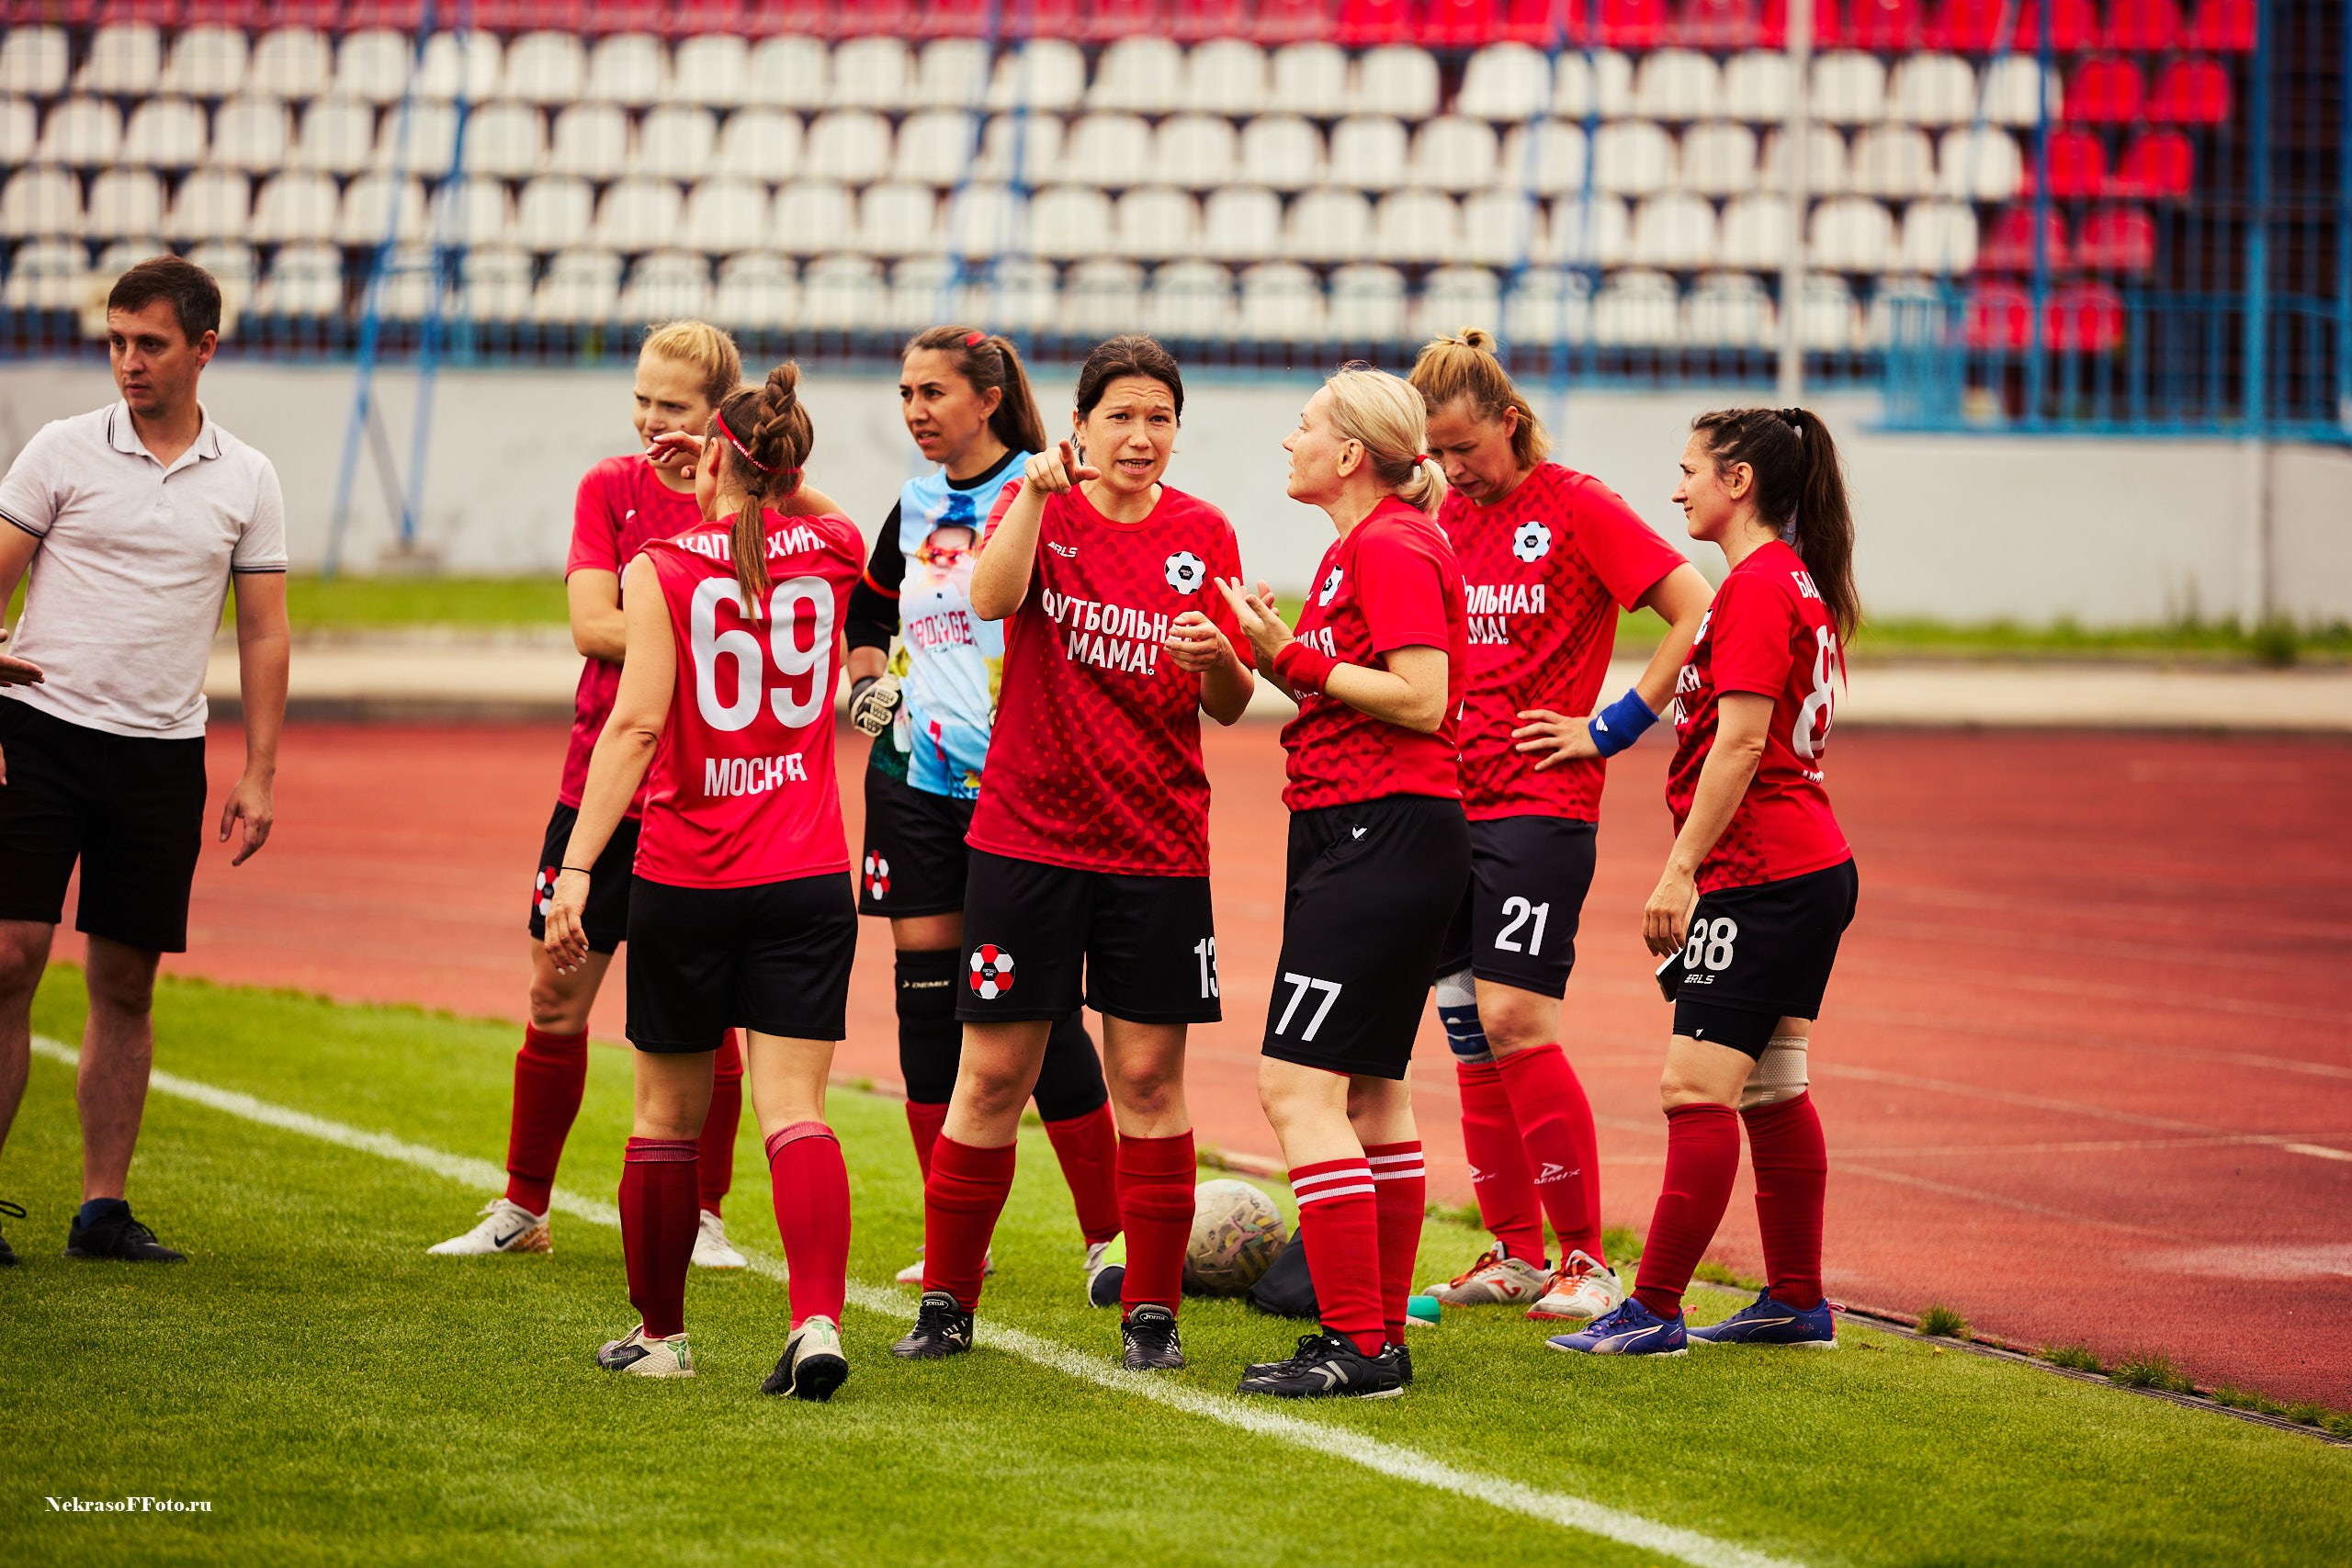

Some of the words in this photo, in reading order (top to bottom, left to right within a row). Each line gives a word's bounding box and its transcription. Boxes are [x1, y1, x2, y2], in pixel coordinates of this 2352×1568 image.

[1042, 587, 1192, 645] ФУТБОЛЬН
[1467, 615, 1510, 645] МА!
[691, 575, 835, 732] 69
[1068, 630, 1156, 676] МАМА!
[1792, 625, 1837, 760] 8
[1494, 896, 1550, 956] 21
[1683, 917, 1738, 971] 88
[1193, 936, 1219, 998] 13
[1274, 972, 1342, 1042] 77
[1533, 1168, 1580, 1184] DEMIX
